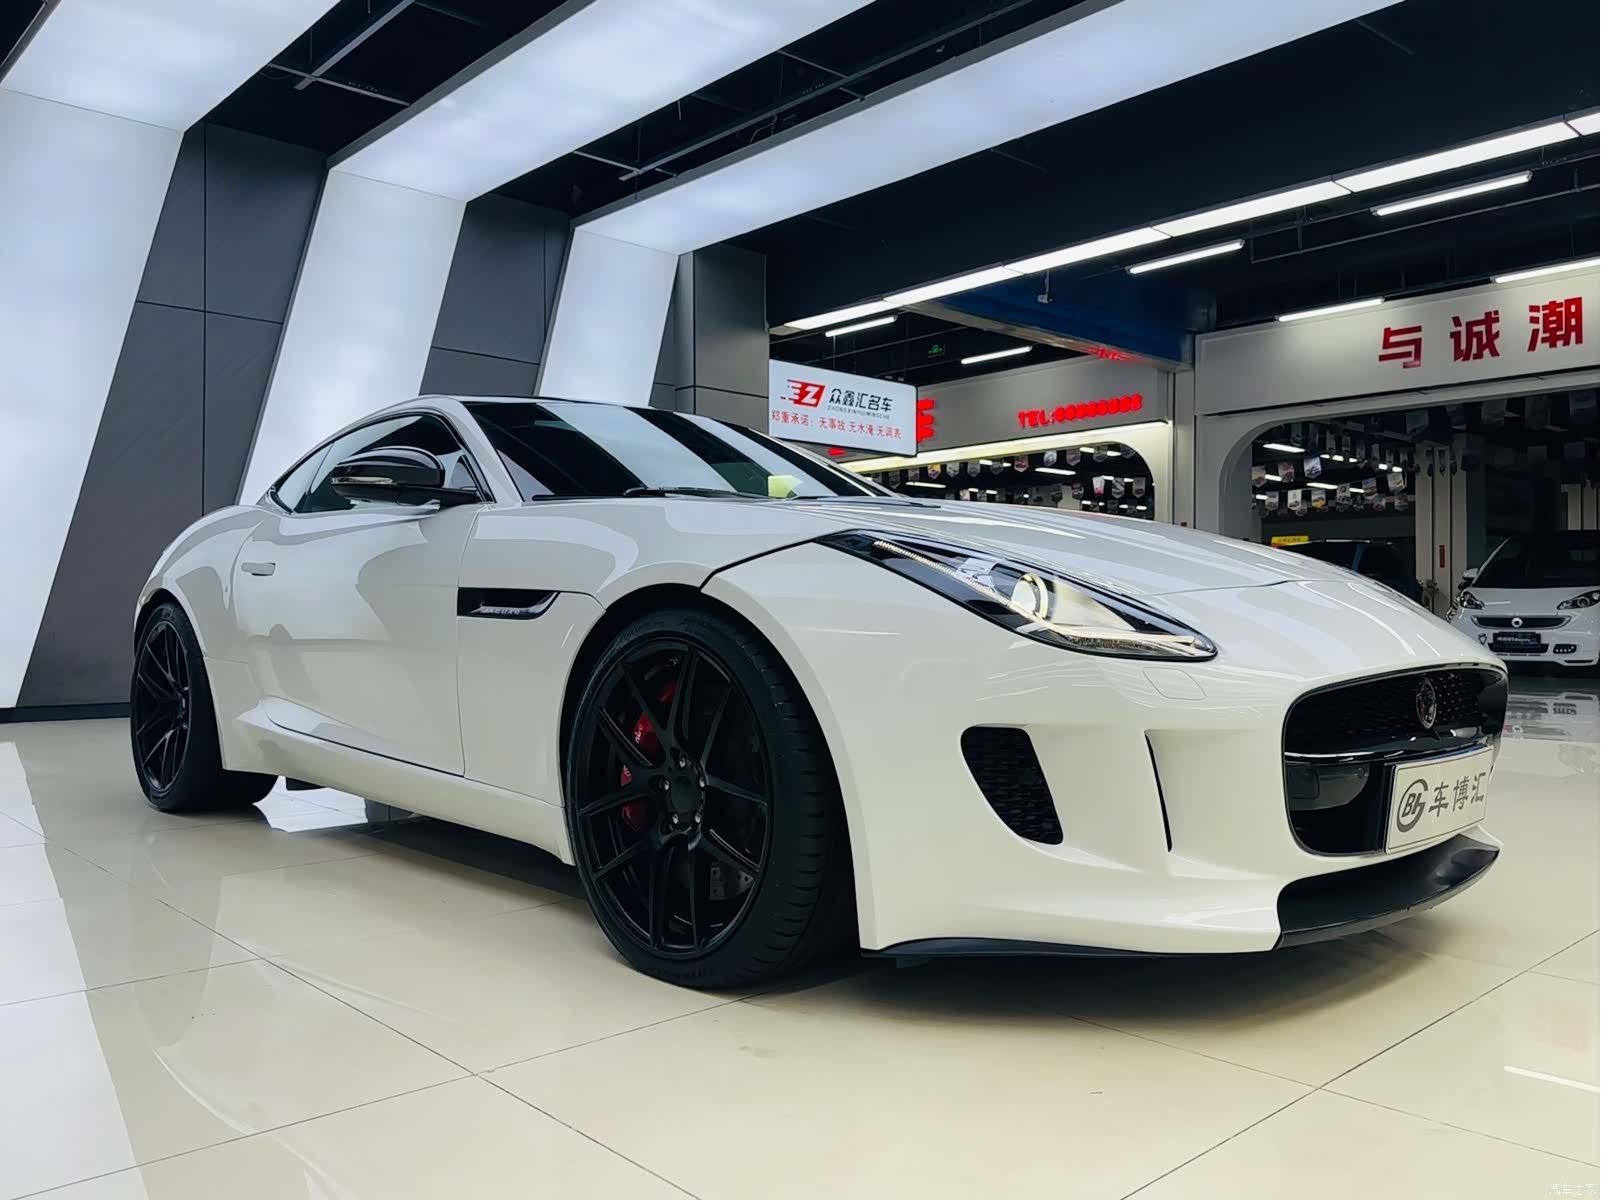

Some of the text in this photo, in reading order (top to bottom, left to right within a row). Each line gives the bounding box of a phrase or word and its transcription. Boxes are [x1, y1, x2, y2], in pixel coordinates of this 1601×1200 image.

[1378, 296, 1584, 369] 与诚潮
[828, 388, 893, 412] 众鑫汇名车
[483, 607, 521, 615] JAGUAR
[1428, 771, 1487, 818] 车博汇
